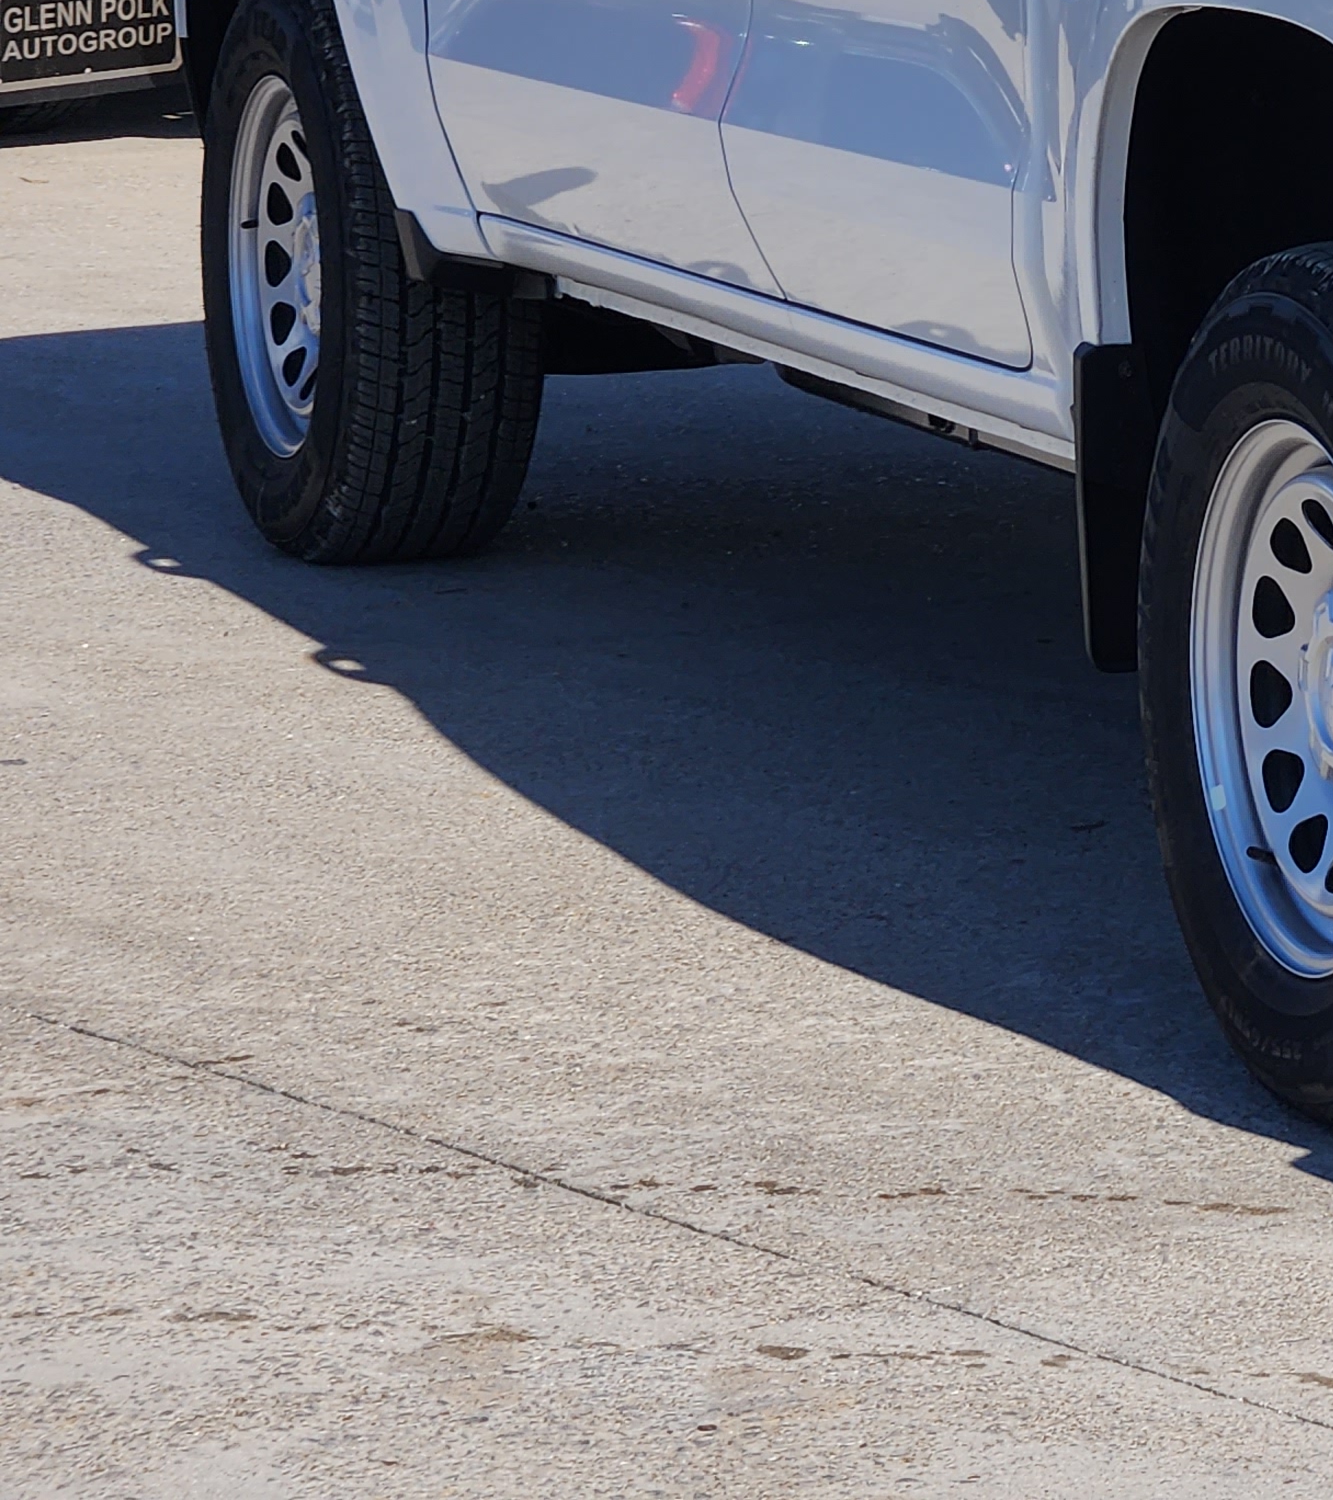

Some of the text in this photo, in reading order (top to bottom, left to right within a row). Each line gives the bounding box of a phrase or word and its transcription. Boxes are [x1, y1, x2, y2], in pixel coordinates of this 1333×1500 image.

[4, 0, 93, 34] GLENN
[1, 22, 173, 63] AUTOGROUP
[1207, 334, 1313, 384] TERRITORY
